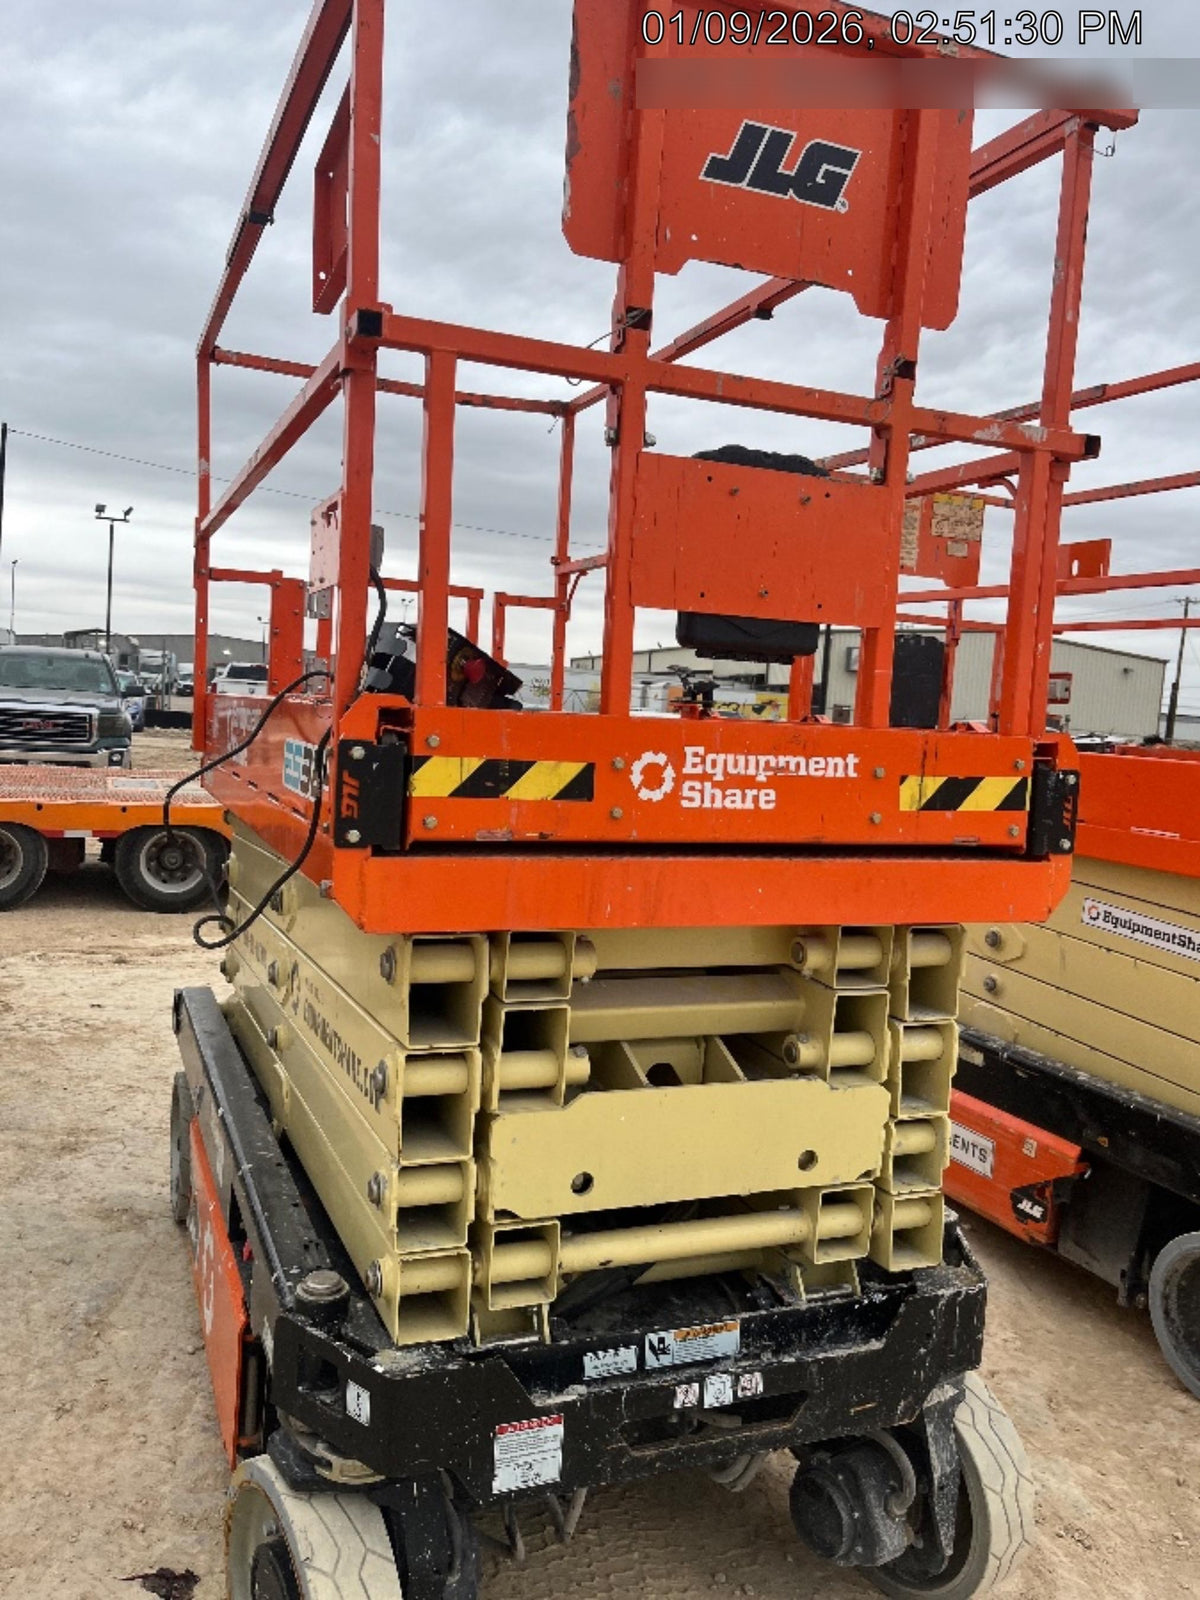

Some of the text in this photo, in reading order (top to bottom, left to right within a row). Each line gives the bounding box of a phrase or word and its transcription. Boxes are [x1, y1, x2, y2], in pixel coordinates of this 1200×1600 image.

[699, 119, 862, 212] JLG
[682, 746, 859, 782] Equipment
[341, 769, 360, 819] JLG
[681, 780, 777, 810] Share
[949, 1134, 988, 1164] ENTS
[1017, 1198, 1045, 1219] JLG
